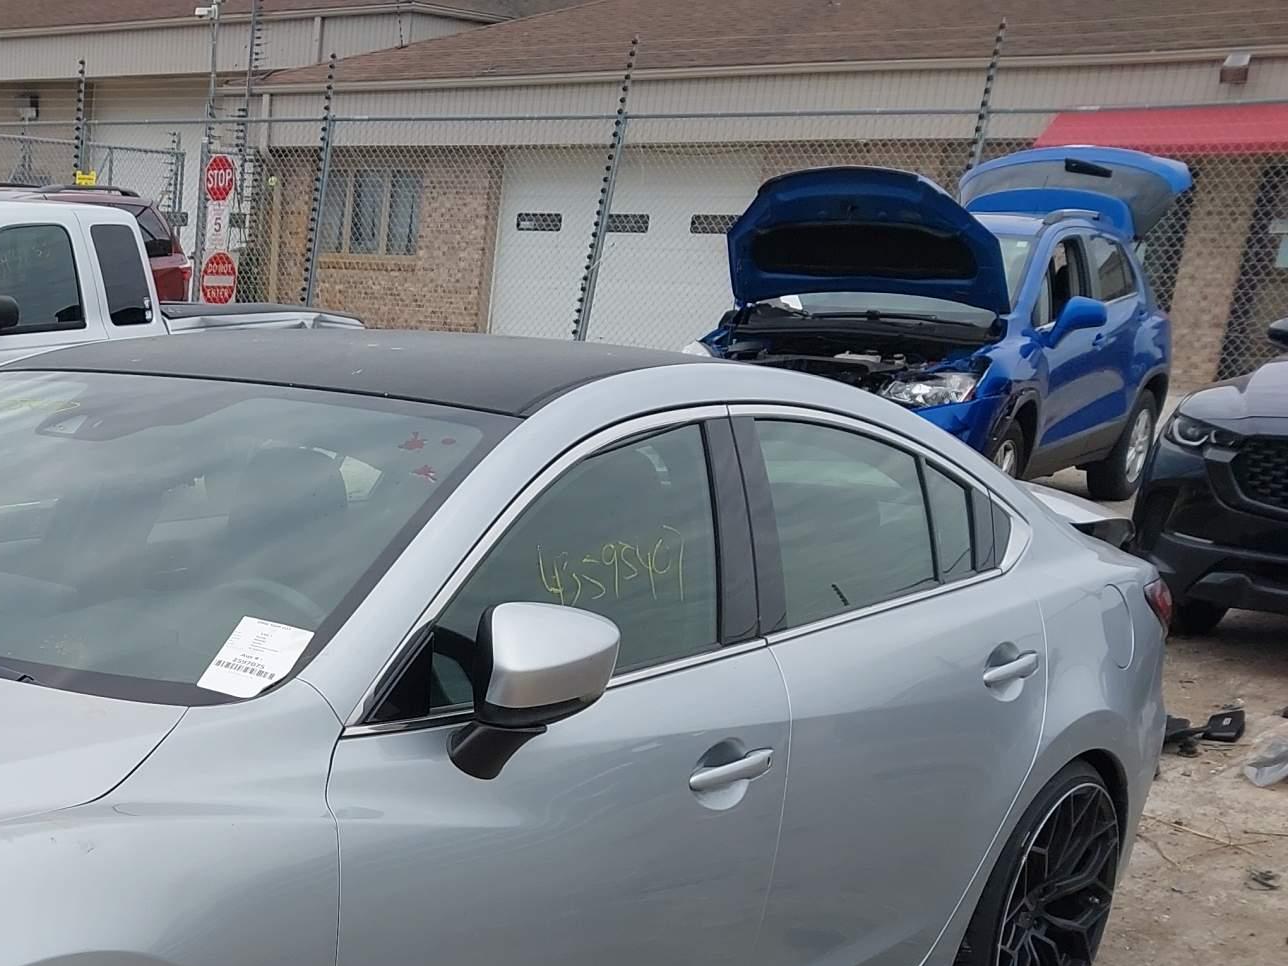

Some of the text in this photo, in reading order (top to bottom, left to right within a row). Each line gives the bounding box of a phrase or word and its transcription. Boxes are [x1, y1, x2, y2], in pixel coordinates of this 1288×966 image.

[208, 169, 232, 188] STOP
[214, 217, 222, 232] 5
[208, 263, 232, 273] DO NOT
[207, 288, 232, 298] ENTER
